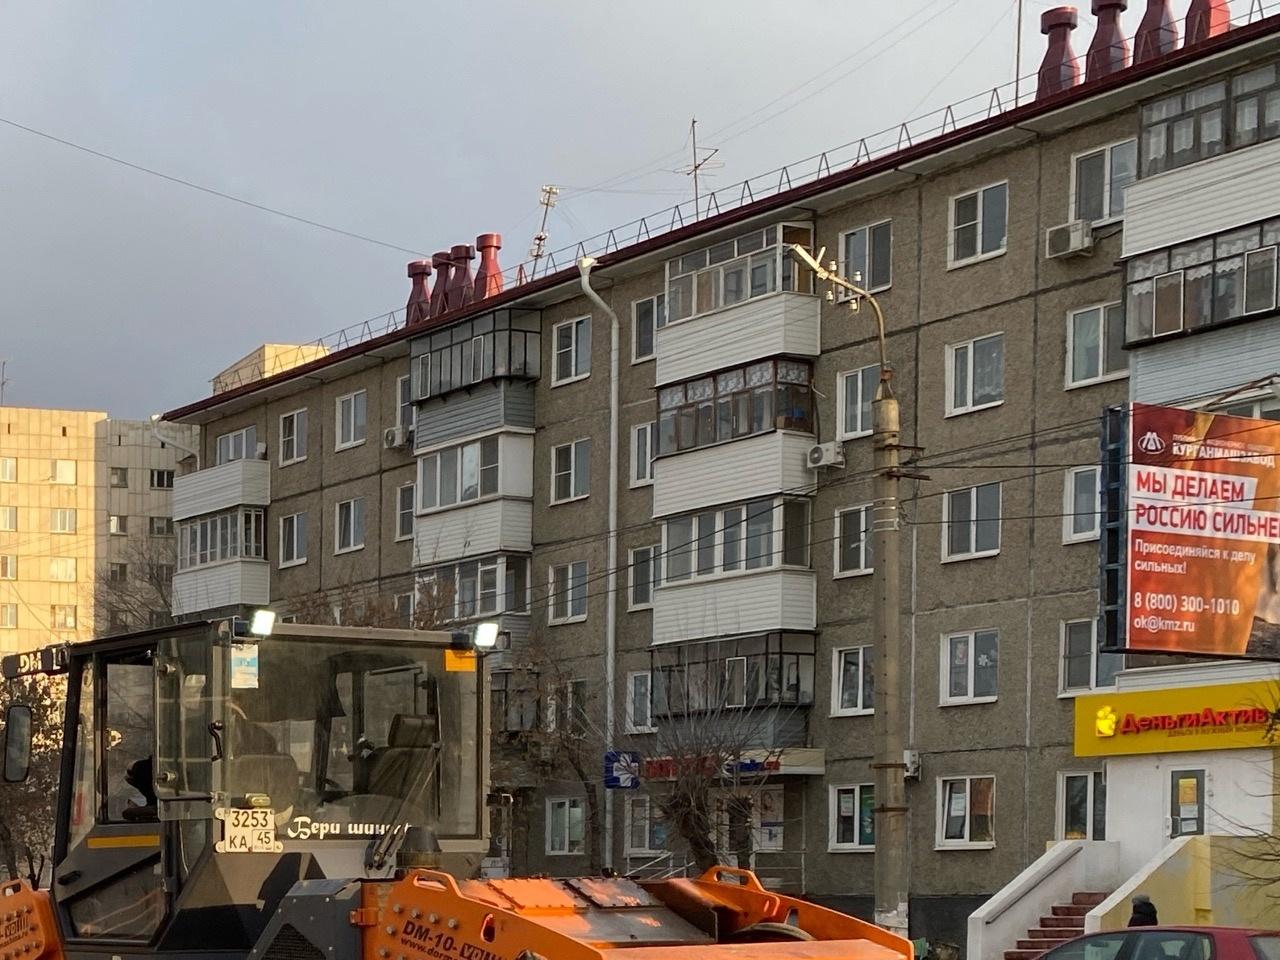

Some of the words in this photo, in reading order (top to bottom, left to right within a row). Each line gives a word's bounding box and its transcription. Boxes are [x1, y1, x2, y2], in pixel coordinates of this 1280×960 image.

[1137, 470, 1166, 494] МЫ
[1172, 475, 1245, 502] ДЕЛАЕМ
[1136, 503, 1207, 530] РОССИЮ
[1213, 511, 1280, 538] СИЛЬНЕ
[1135, 538, 1221, 559] Присоединяйся
[1231, 550, 1256, 565] делу
[1134, 560, 1187, 574] сильных!
[1134, 592, 1142, 608] 8
[1145, 592, 1178, 613] (800)
[1181, 595, 1240, 615] 300-1010
[1134, 615, 1195, 633] ok@kmz.ru
[1121, 707, 1269, 735] ДеньгиАктив
[232, 810, 268, 828] 3253
[287, 816, 340, 840] Бери
[257, 831, 271, 844] 45
